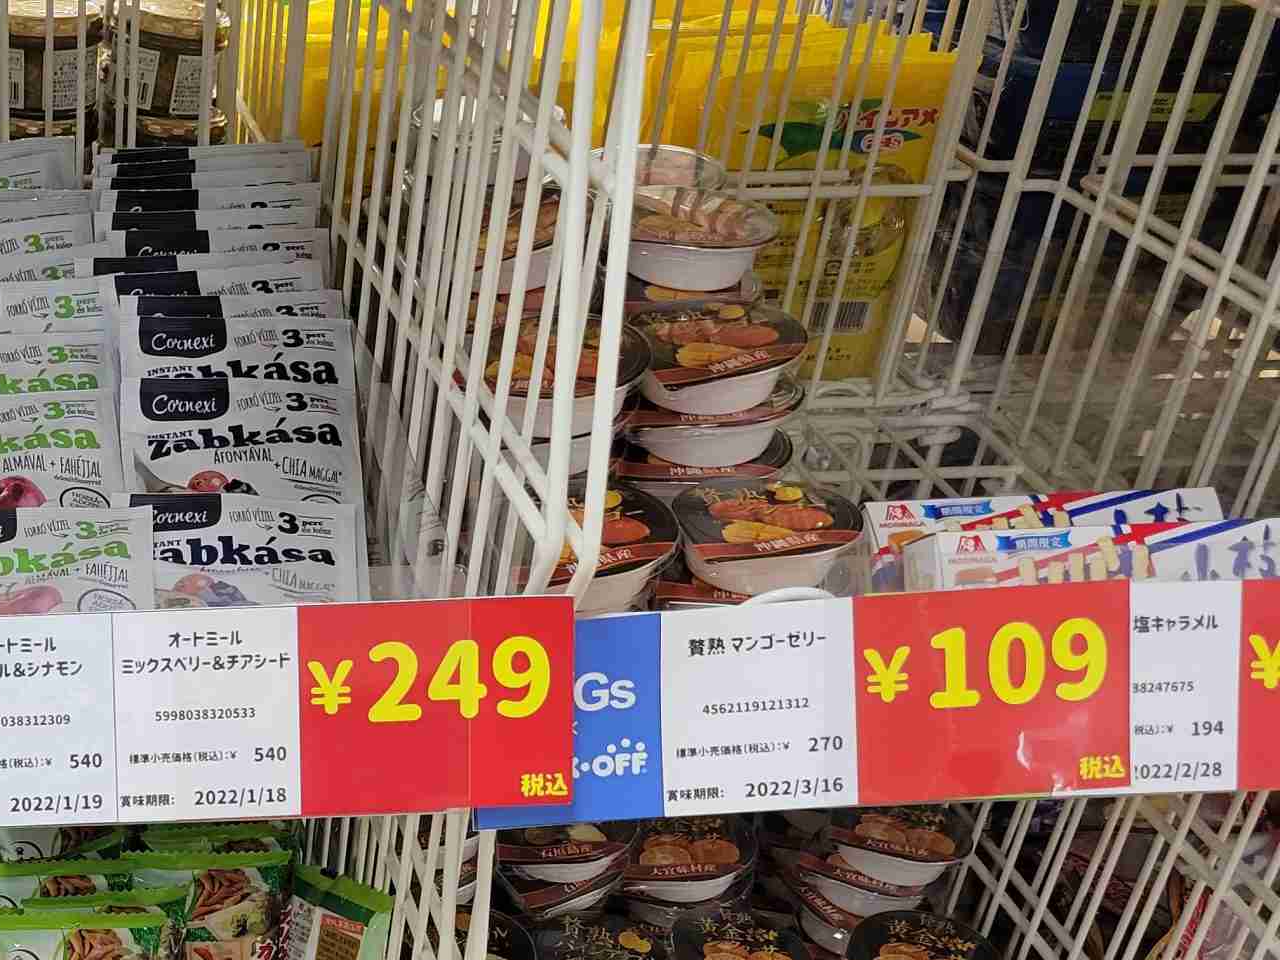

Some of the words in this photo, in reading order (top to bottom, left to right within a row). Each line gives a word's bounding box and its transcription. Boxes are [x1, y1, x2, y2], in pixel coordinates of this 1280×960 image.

[54, 295, 76, 319] 3
[151, 333, 216, 351] Cornexi
[152, 394, 217, 415] Cornexi
[148, 417, 343, 461] zabkása
[1133, 614, 1219, 634] 塩キャラメル
[168, 630, 242, 649] オートミール
[574, 671, 637, 712] Gs
[154, 707, 256, 723] 5998038320533
[702, 697, 810, 716] 4562119121312
[1191, 720, 1224, 737] 194
[808, 735, 843, 753] 270
[69, 753, 103, 769] 540
[253, 746, 288, 763] 540
[1079, 755, 1125, 780] 税込
[520, 772, 569, 798] 税込
[745, 776, 844, 798] 2022/3/16
[10, 794, 103, 814] 2022/1/19
[194, 787, 287, 807] 2022/1/18
